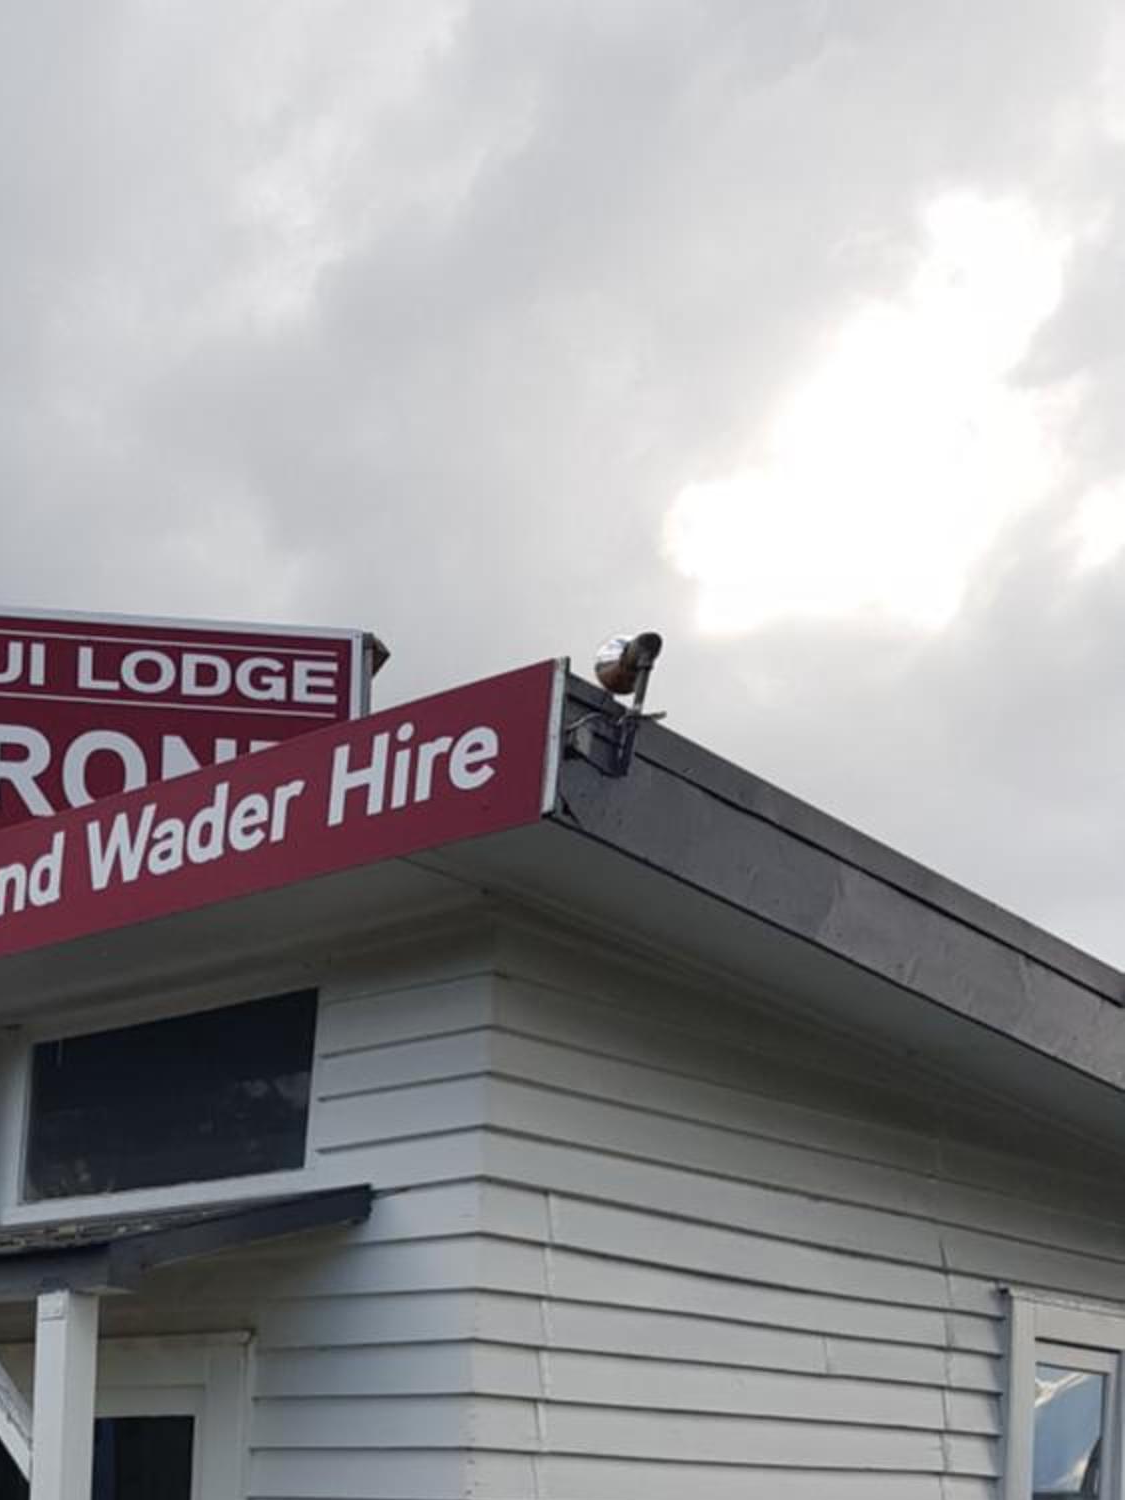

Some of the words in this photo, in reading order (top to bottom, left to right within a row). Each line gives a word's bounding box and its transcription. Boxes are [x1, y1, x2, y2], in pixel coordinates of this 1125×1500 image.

[78, 646, 338, 704] LODGE
[86, 780, 305, 891] Wader
[327, 722, 499, 827] Hire
